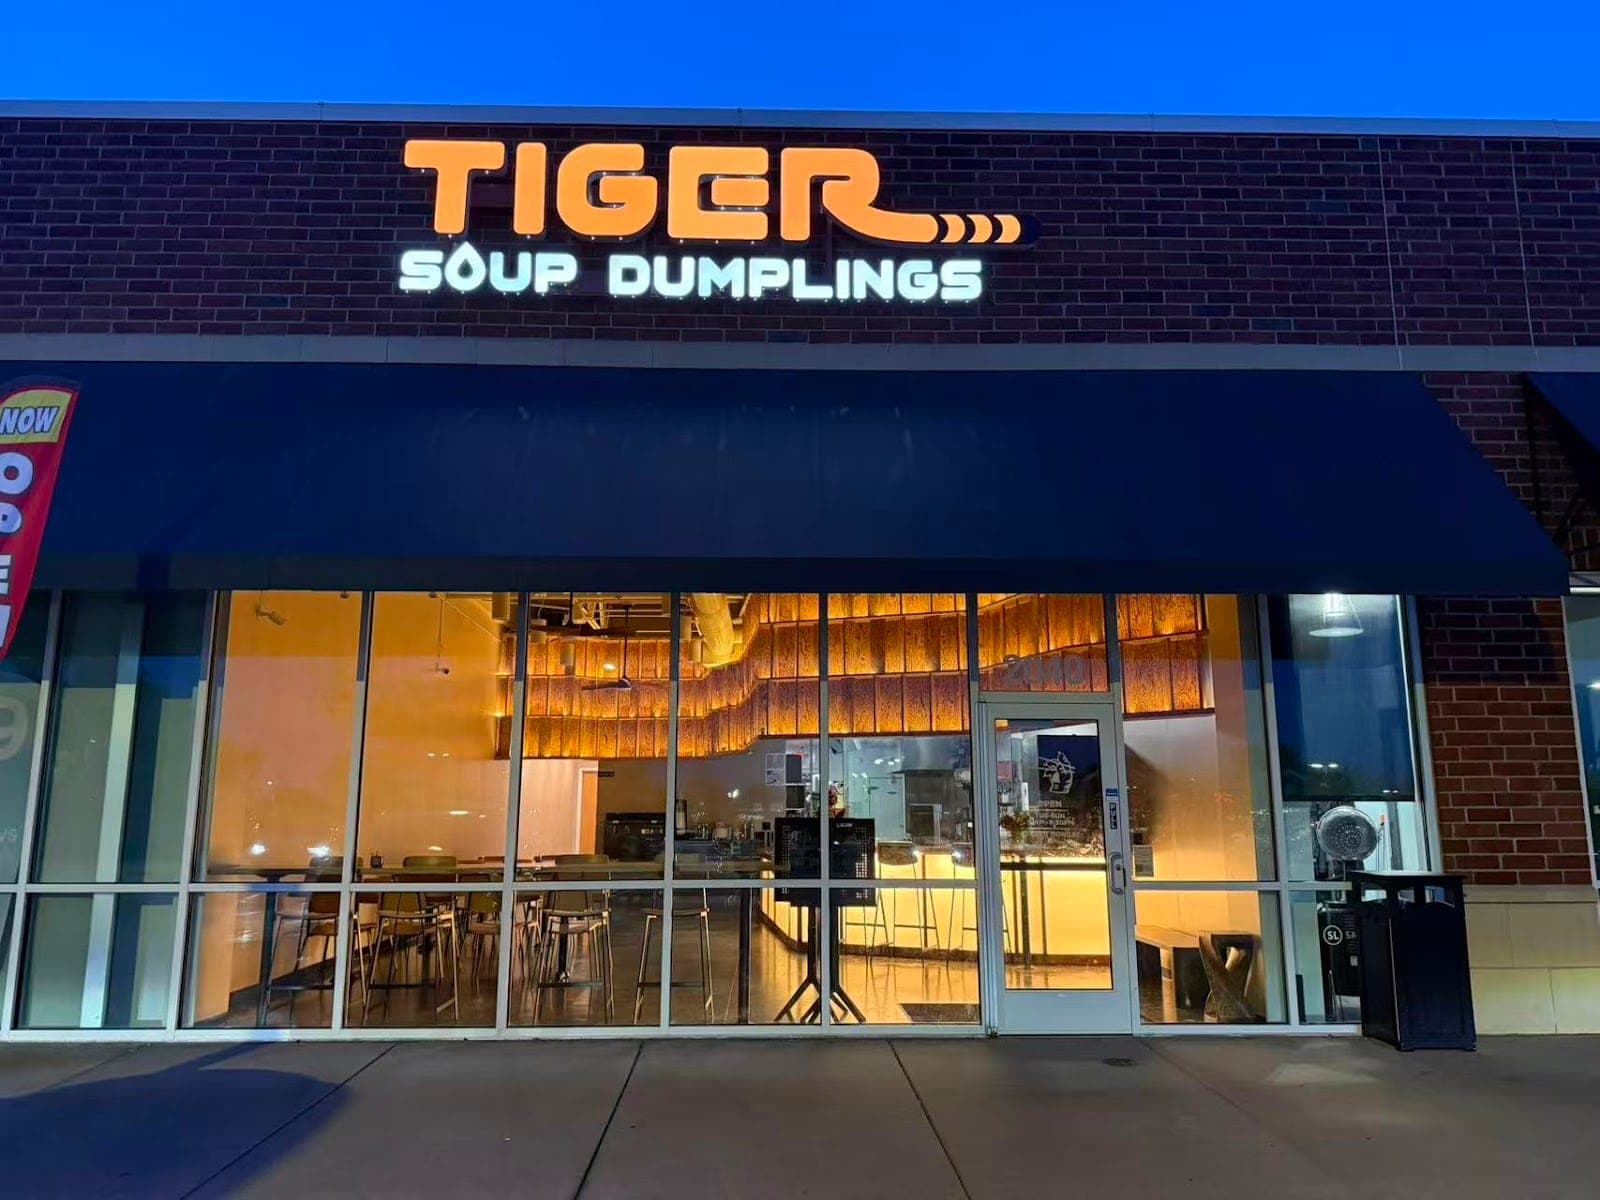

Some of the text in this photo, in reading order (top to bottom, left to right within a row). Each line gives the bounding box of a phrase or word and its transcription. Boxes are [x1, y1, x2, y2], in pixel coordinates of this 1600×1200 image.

[404, 139, 1021, 244] TIGER
[399, 241, 984, 301] SOUP DUMPLINGS
[0, 406, 60, 434] NOW
